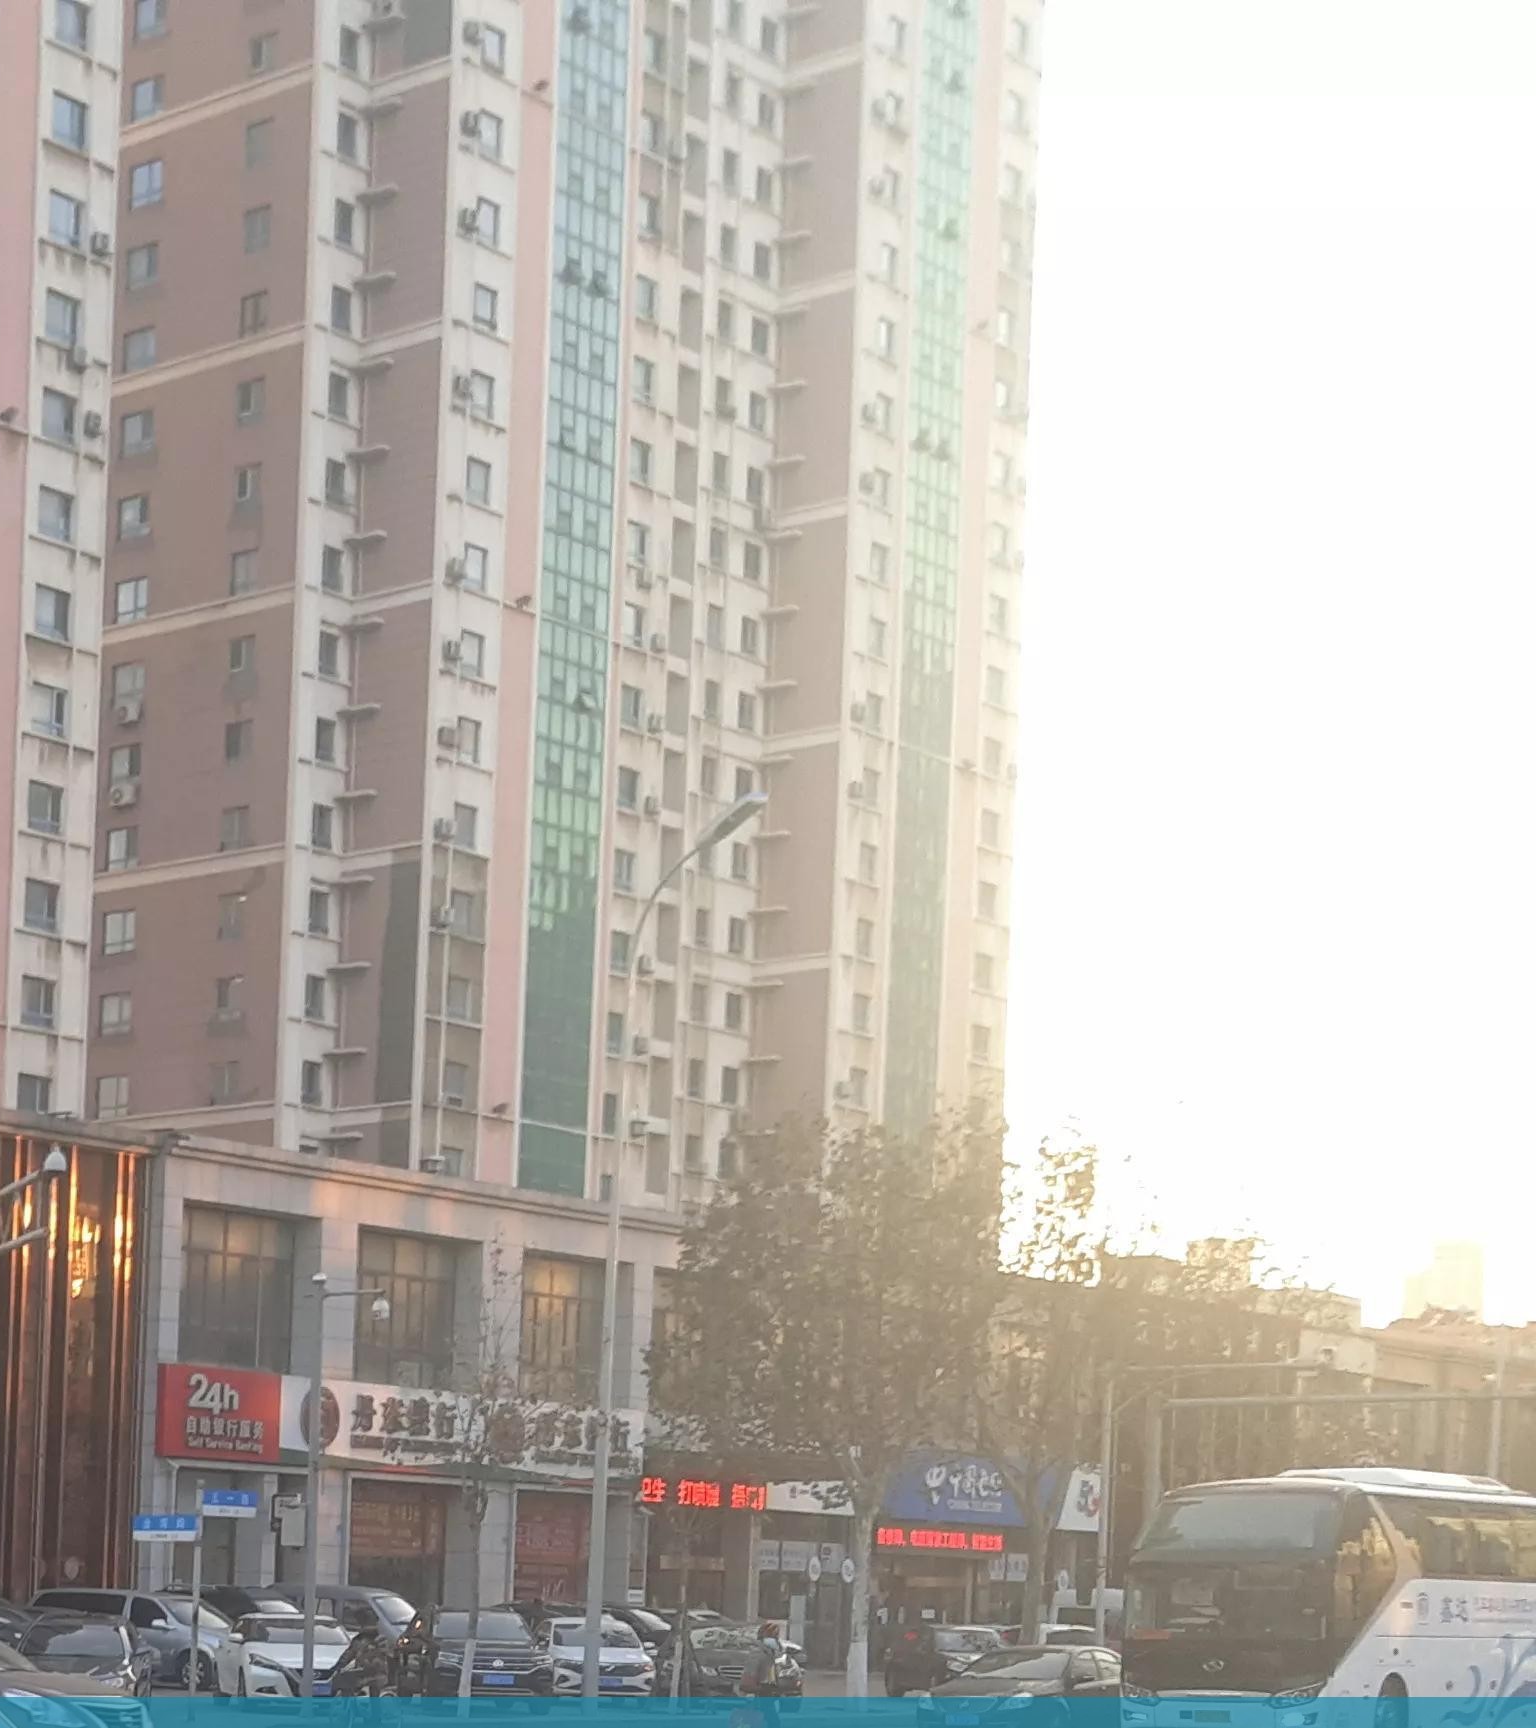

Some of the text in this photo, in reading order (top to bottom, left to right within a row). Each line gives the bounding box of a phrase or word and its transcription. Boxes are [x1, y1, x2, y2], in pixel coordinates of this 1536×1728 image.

[187, 1373, 240, 1416] 24h
[185, 1415, 265, 1440] 自助银行服务
